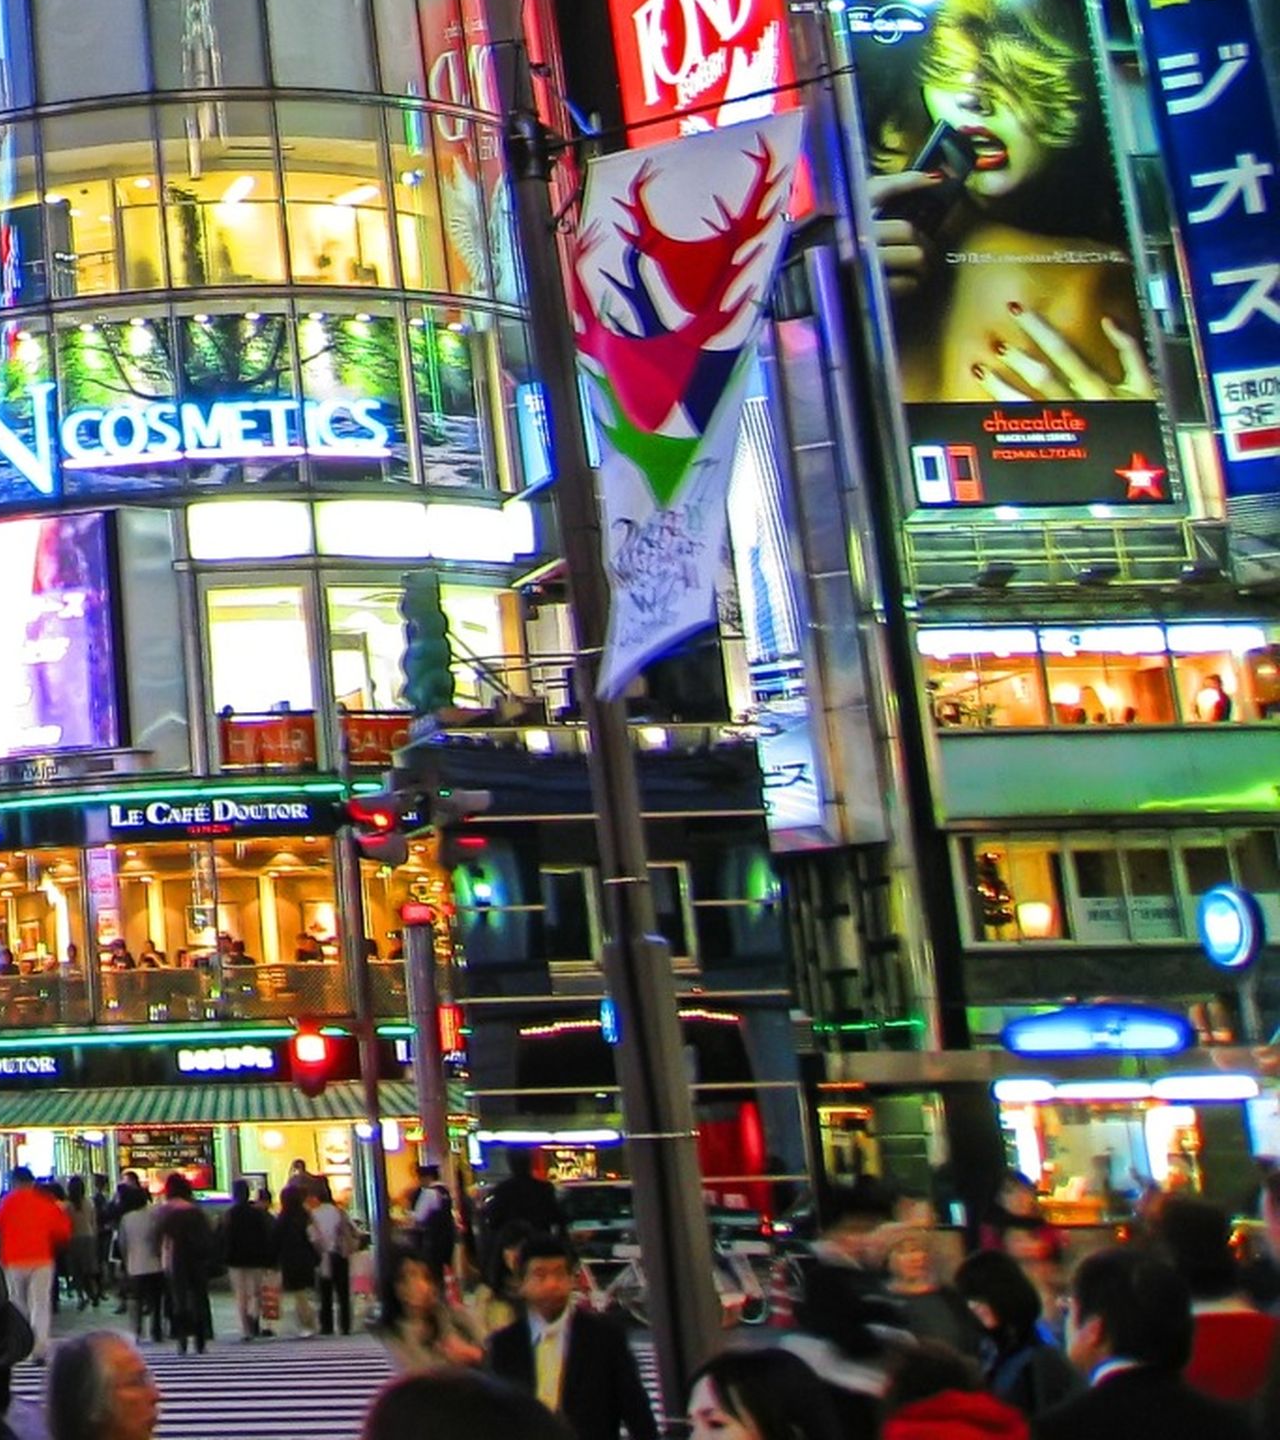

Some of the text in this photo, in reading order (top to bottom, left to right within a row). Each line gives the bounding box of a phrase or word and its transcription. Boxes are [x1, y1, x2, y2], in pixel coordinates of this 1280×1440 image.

[60, 398, 389, 458] COSMETICS
[227, 725, 308, 755] HAIR
[110, 798, 309, 828] LE CAFÉ DOUTOR
